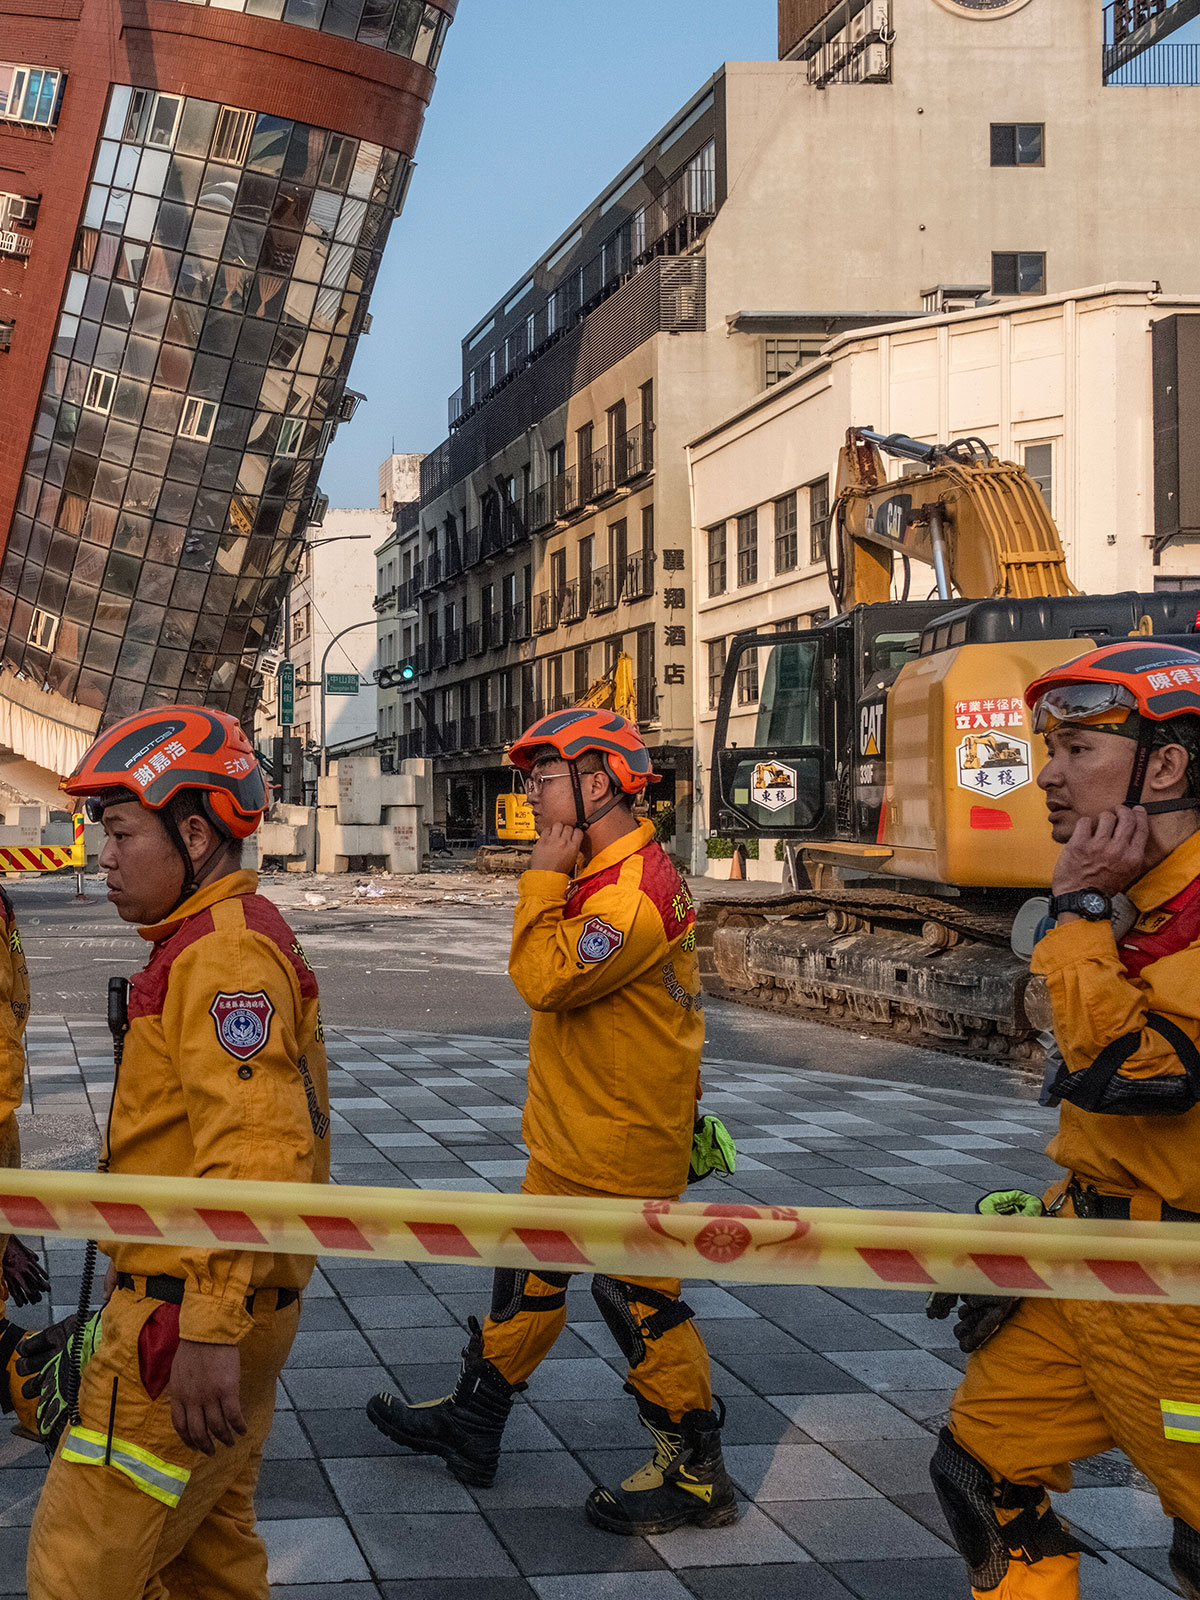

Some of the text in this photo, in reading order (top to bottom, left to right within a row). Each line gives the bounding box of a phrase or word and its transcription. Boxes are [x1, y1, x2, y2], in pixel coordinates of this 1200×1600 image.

[662, 549, 686, 686] 麗翔酒店
[860, 703, 884, 756] CAT
[955, 712, 1024, 730] 立入禁止
[125, 730, 174, 768] PROTOS
[132, 740, 187, 787] 謝嘉浩
